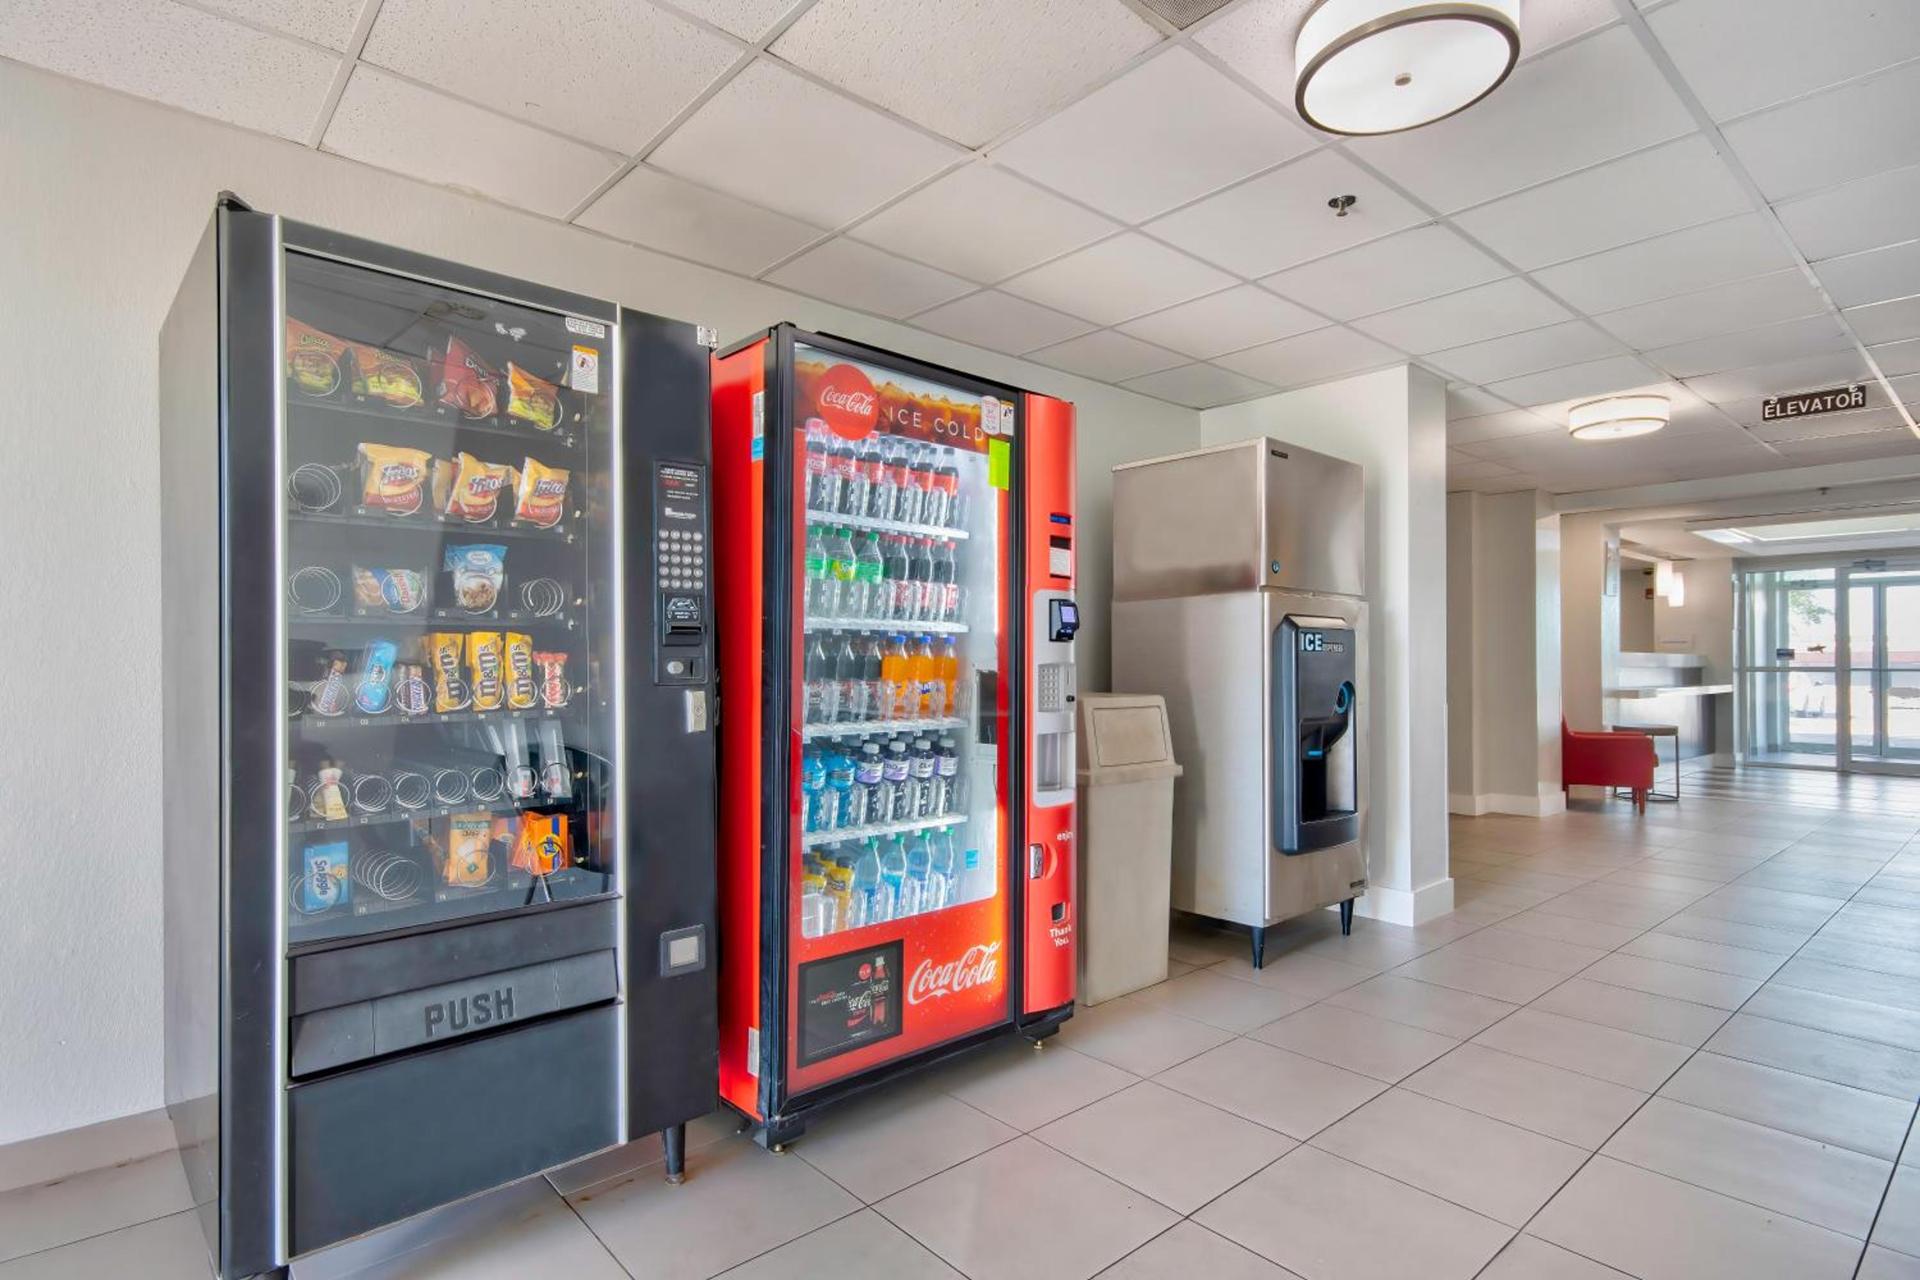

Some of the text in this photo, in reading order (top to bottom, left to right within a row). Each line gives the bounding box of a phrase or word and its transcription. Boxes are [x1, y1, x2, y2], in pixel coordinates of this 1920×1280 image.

[889, 406, 922, 428] ICE
[934, 417, 984, 441] COLD
[1764, 392, 1864, 419] ELEVATOR
[1300, 633, 1322, 651] ICE
[314, 859, 333, 896] Snuggle
[907, 941, 1001, 1006] Coca-Cola
[424, 986, 515, 1038] PUSH
